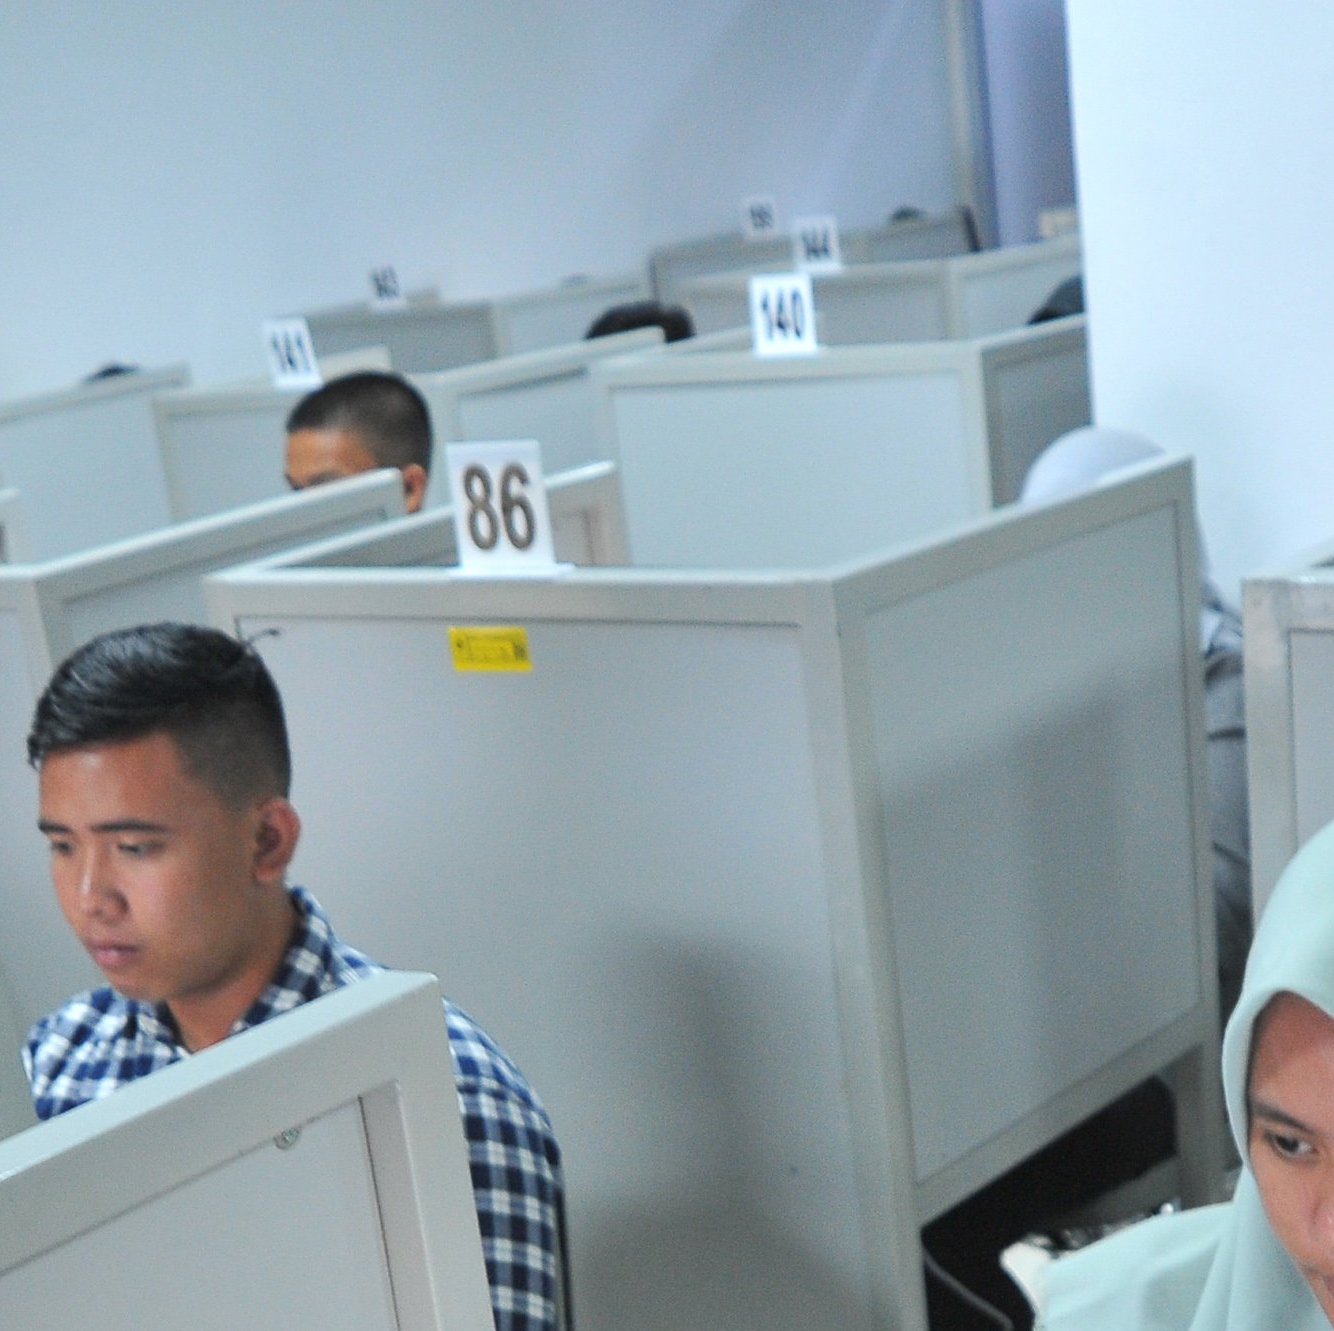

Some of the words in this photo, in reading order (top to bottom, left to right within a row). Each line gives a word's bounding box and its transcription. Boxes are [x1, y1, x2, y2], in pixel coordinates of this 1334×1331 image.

[761, 286, 804, 340] 140
[271, 329, 314, 371] 141
[463, 459, 537, 552] 86
